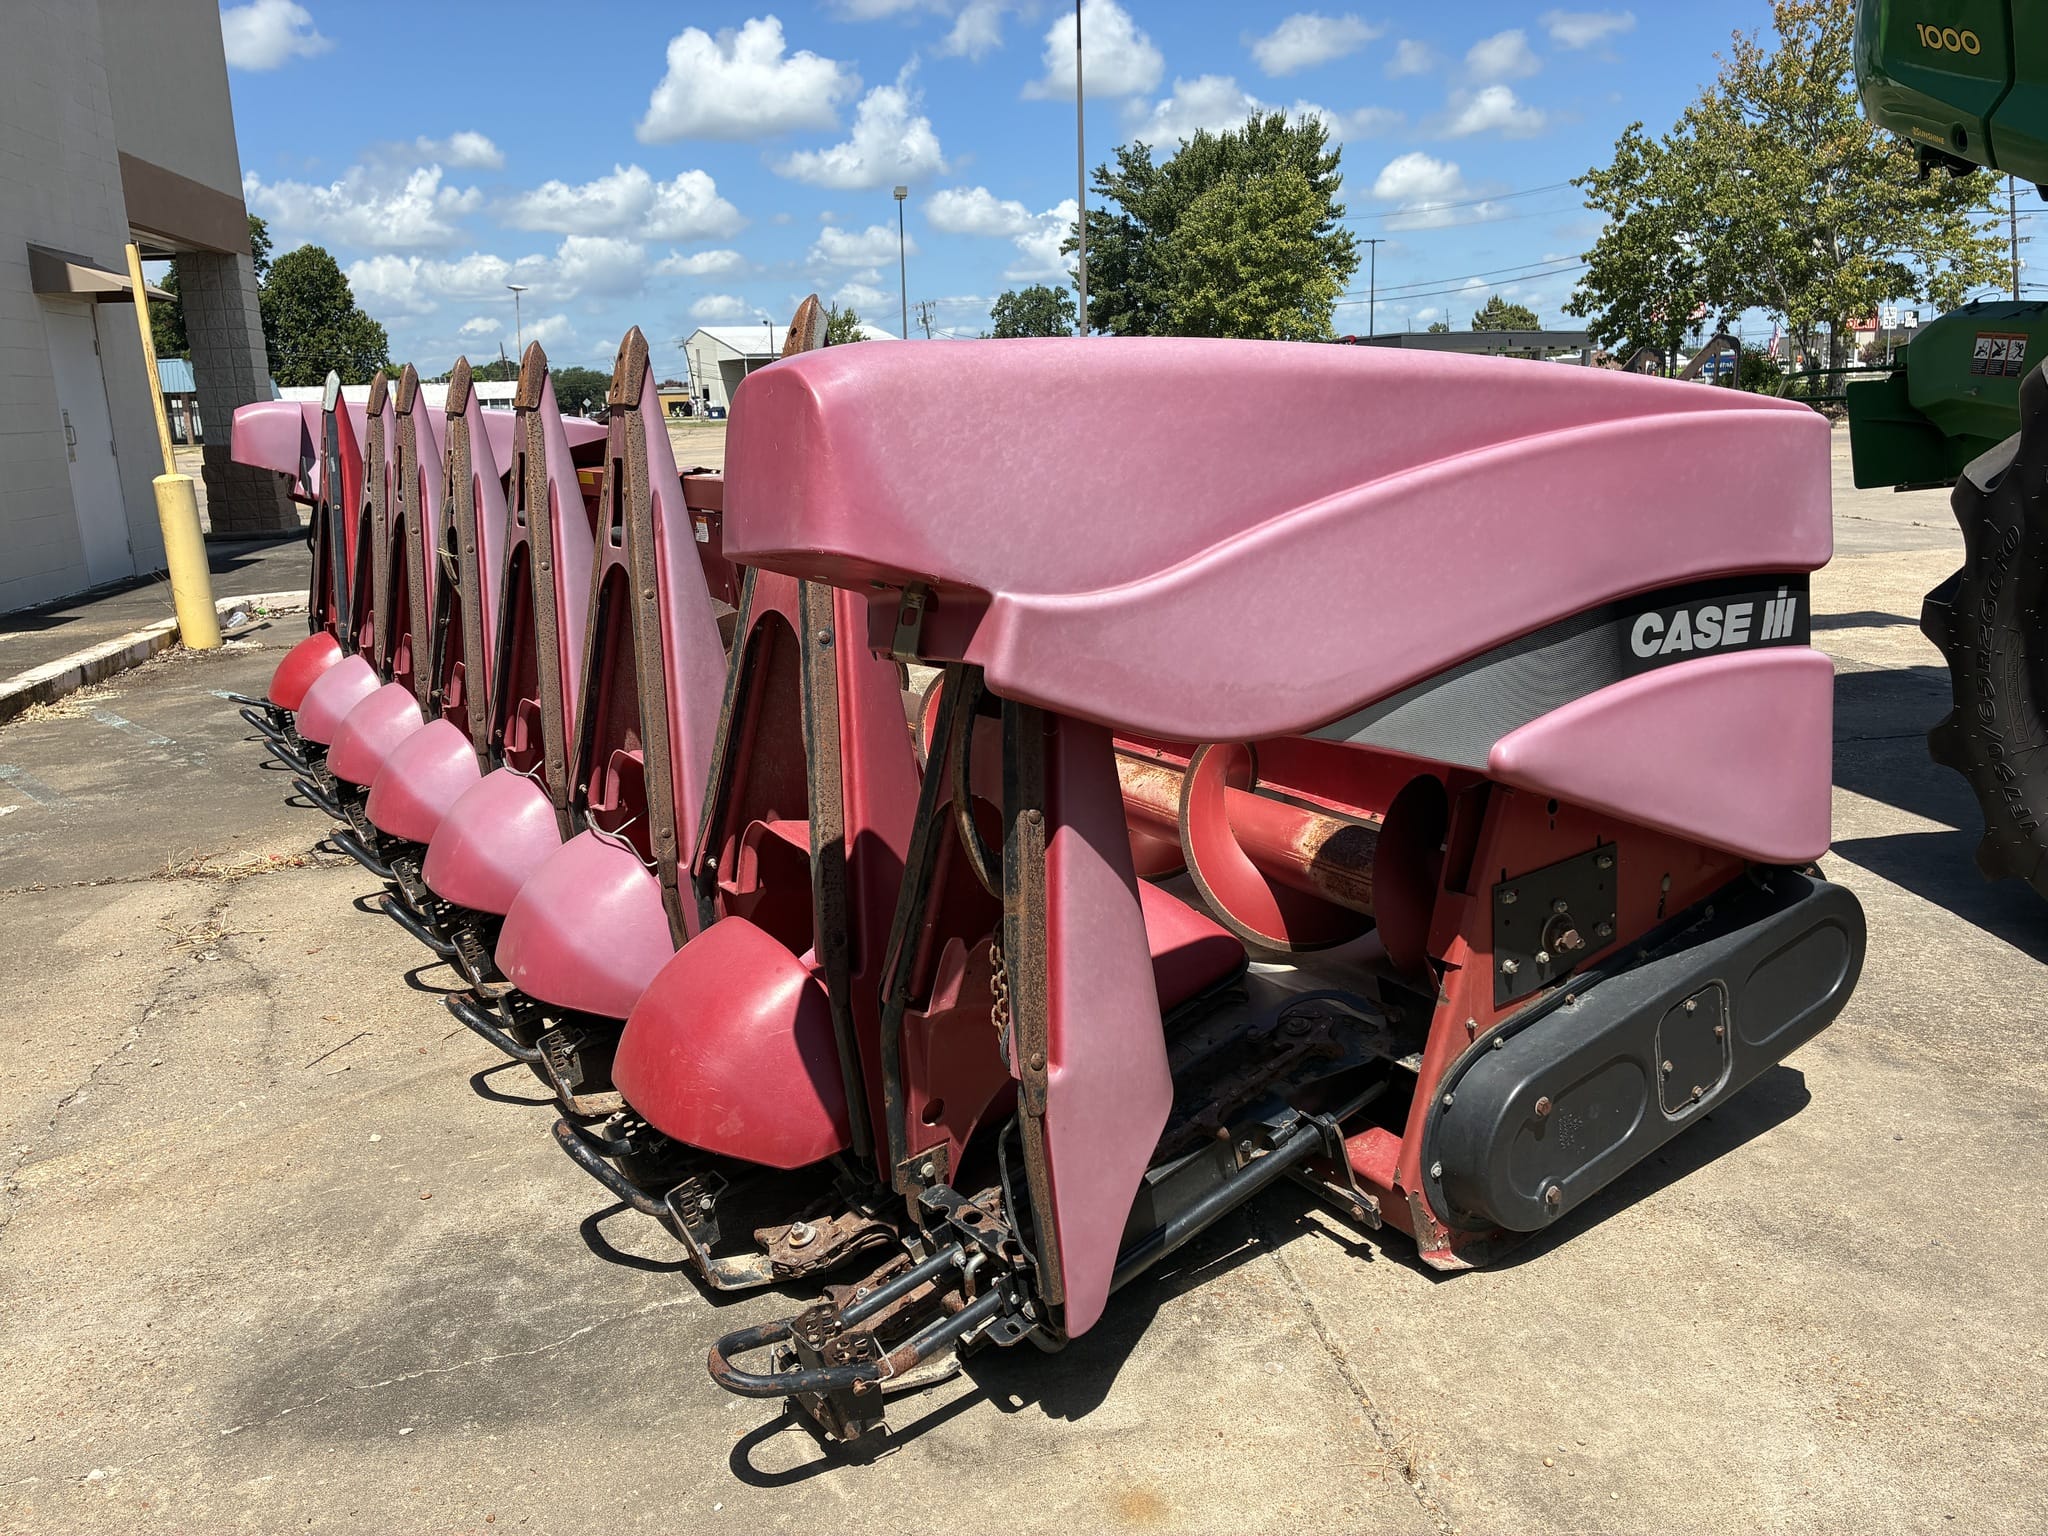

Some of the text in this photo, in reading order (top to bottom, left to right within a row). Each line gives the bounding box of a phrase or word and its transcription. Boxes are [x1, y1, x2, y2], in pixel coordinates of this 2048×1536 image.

[1916, 23, 1981, 55] 1000
[1884, 318, 1896, 327] 35
[1631, 602, 1754, 658] CASE
